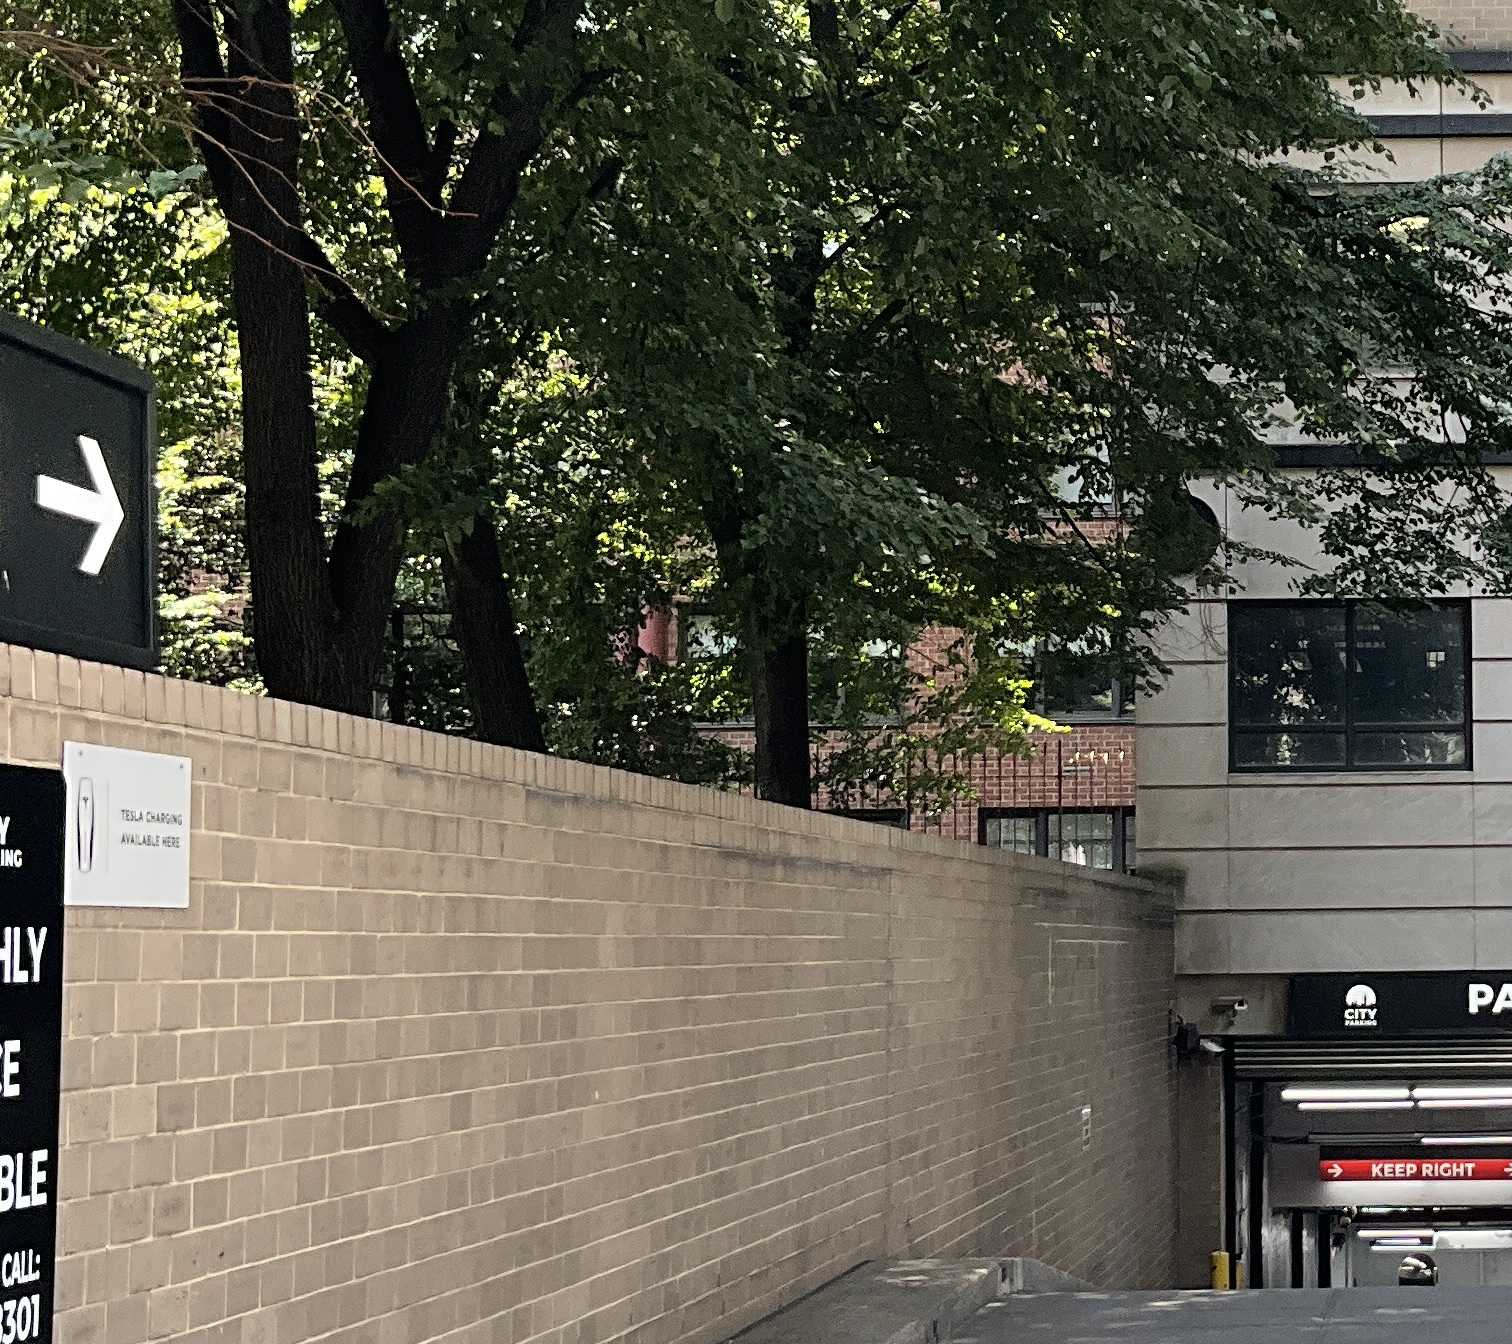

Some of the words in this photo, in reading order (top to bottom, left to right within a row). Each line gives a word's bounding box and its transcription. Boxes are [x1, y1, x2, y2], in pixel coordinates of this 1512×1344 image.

[120, 808, 144, 822] TESLA
[146, 810, 183, 826] CHARGING
[121, 833, 160, 848] AVAILABLE
[162, 836, 181, 849] HERE
[1344, 1008, 1379, 1020] CITY
[1371, 1163, 1418, 1177] KEEP
[1421, 1162, 1476, 1177] RIGHT
[1, 1248, 41, 1288] CALL:
